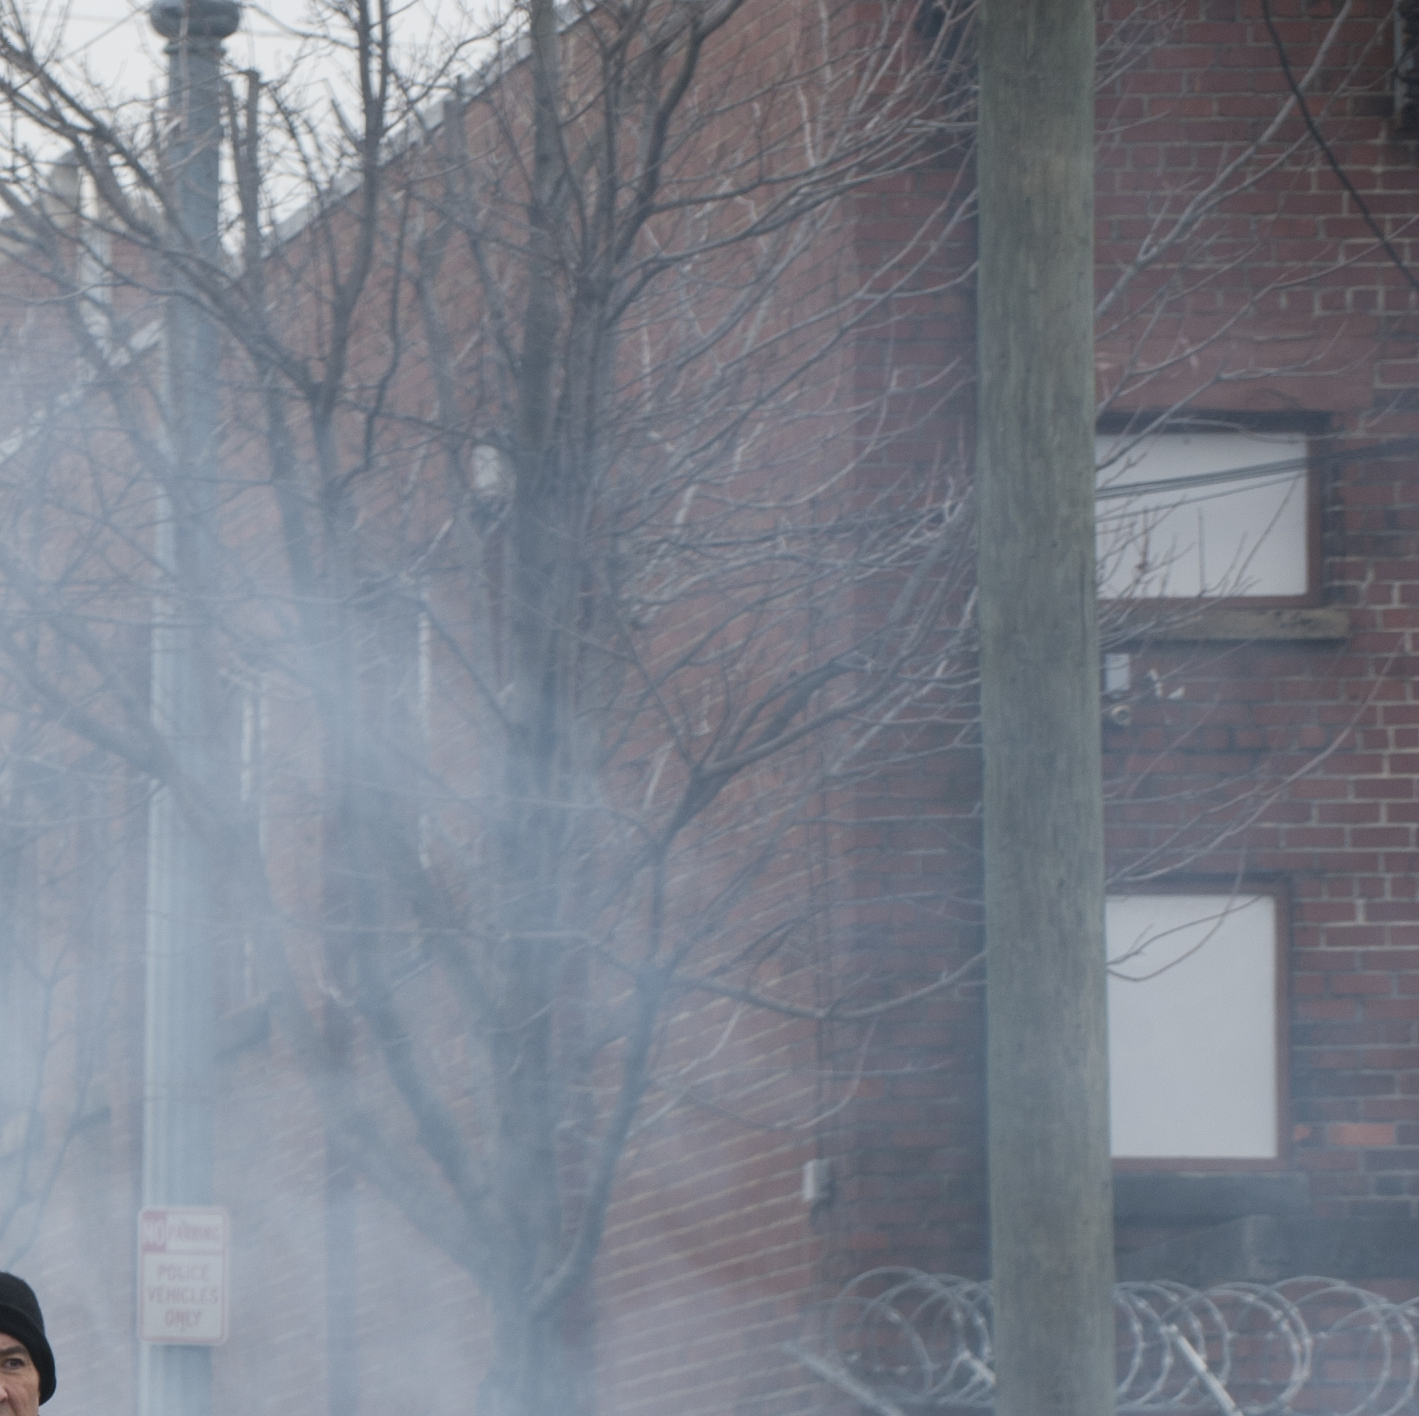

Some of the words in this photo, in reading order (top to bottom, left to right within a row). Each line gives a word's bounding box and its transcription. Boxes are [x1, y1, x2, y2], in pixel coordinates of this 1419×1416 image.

[143, 1220, 166, 1245] NO
[168, 1224, 221, 1243] PARKING
[157, 1263, 209, 1282] POLICE
[147, 1286, 220, 1304] VEHICLES
[164, 1309, 202, 1327] ONLY
